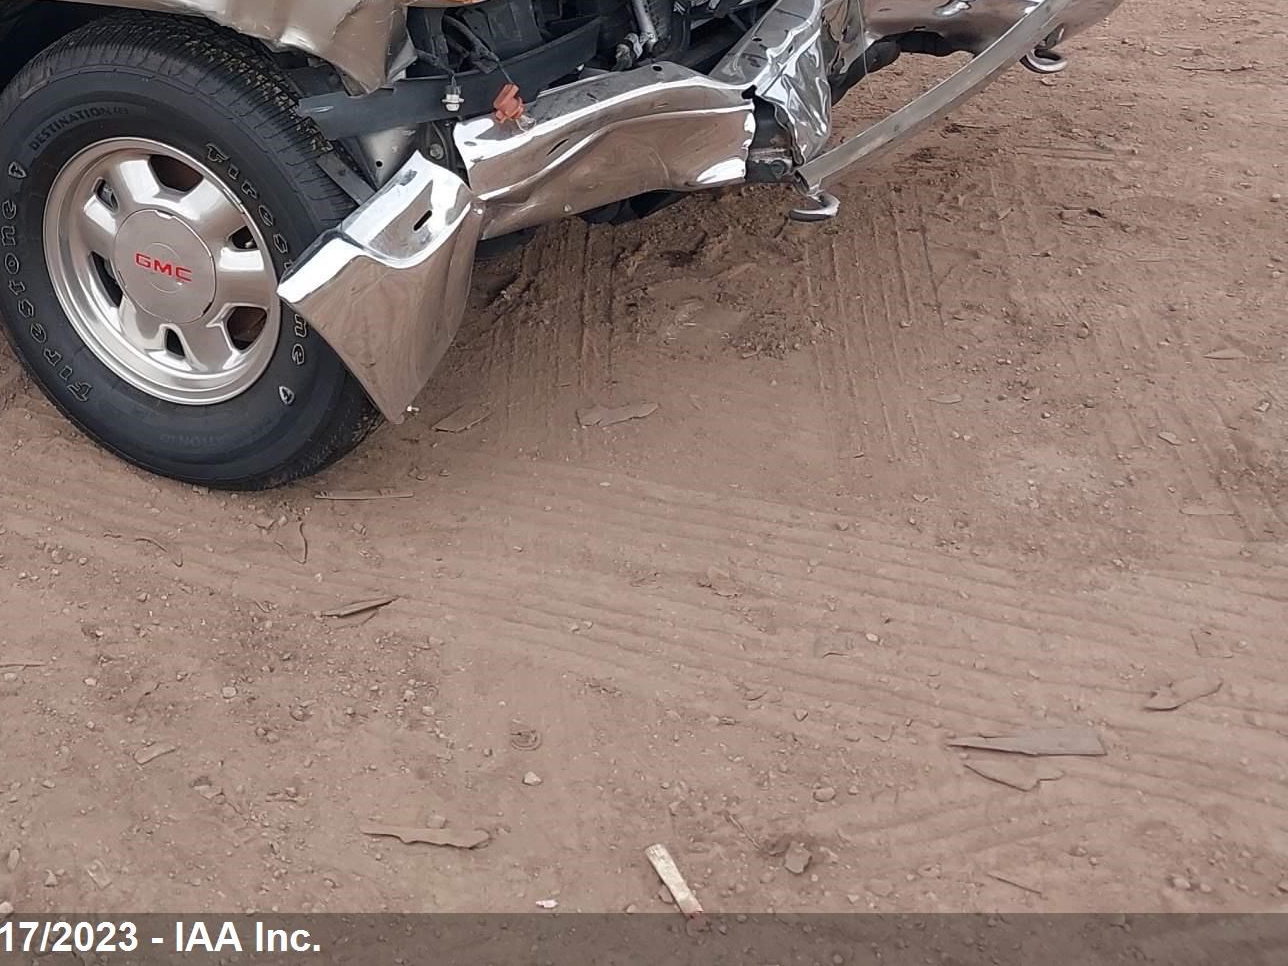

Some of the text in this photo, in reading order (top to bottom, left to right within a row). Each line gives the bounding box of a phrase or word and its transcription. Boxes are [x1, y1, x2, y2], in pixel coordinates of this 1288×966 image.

[29, 106, 112, 151] DESTINATION
[1, 199, 92, 402] Firestone
[135, 253, 192, 282] GMC
[206, 143, 309, 365] Firesne
